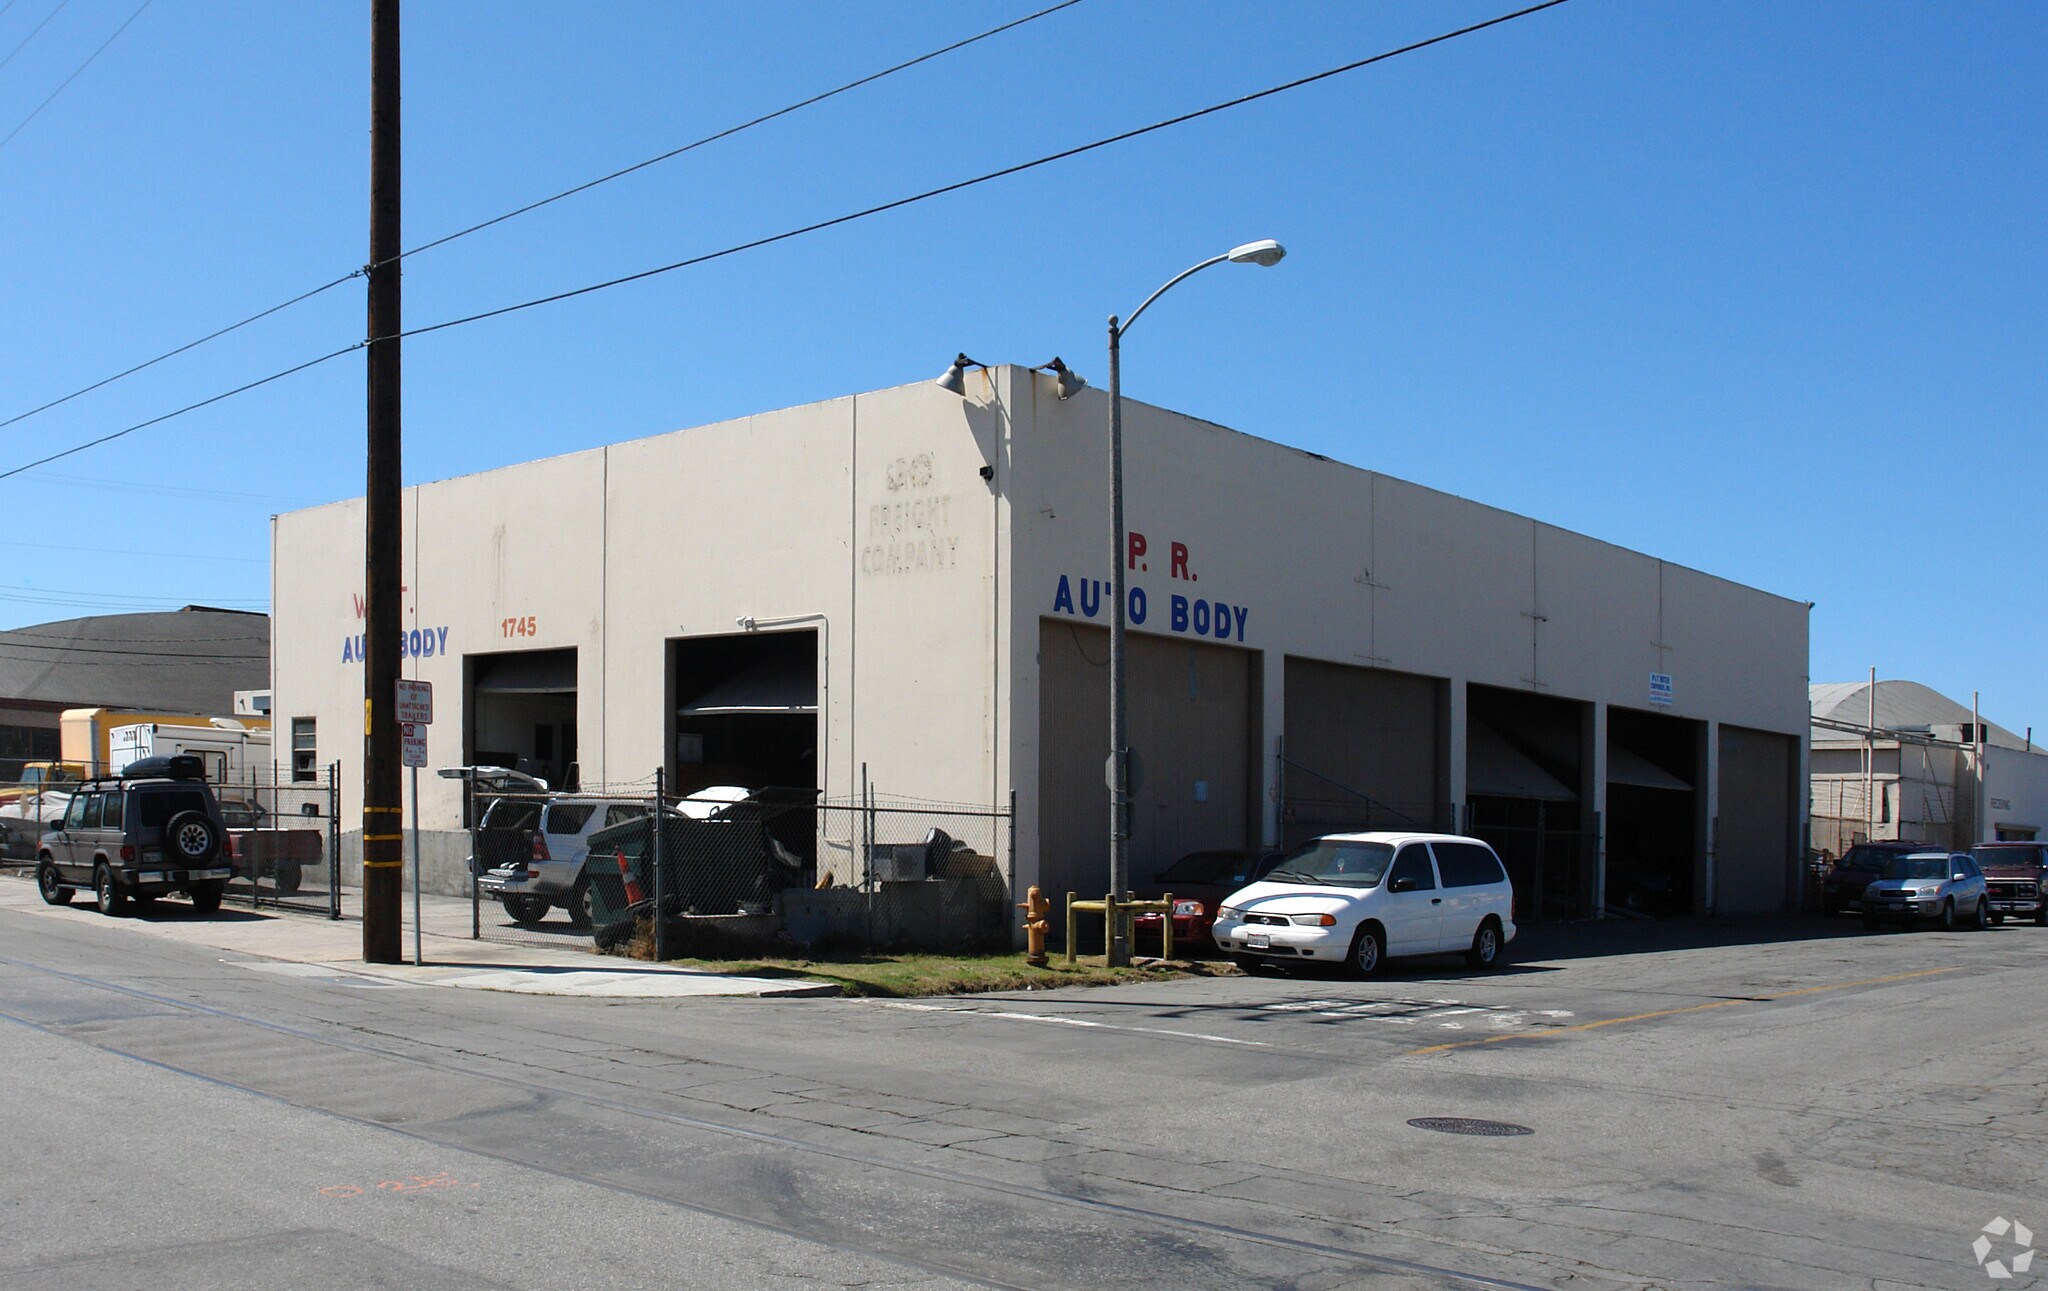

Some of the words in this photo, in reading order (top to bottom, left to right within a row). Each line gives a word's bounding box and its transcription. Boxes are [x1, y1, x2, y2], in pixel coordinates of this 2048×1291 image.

[1129, 532, 1147, 571] P.
[1171, 542, 1198, 581] R.
[1053, 574, 1147, 626] AUO
[1171, 594, 1248, 642] BODY
[501, 616, 537, 638] 1745
[408, 684, 429, 693] PARKING
[404, 725, 413, 735] NO
[404, 738, 425, 747] PARKING
